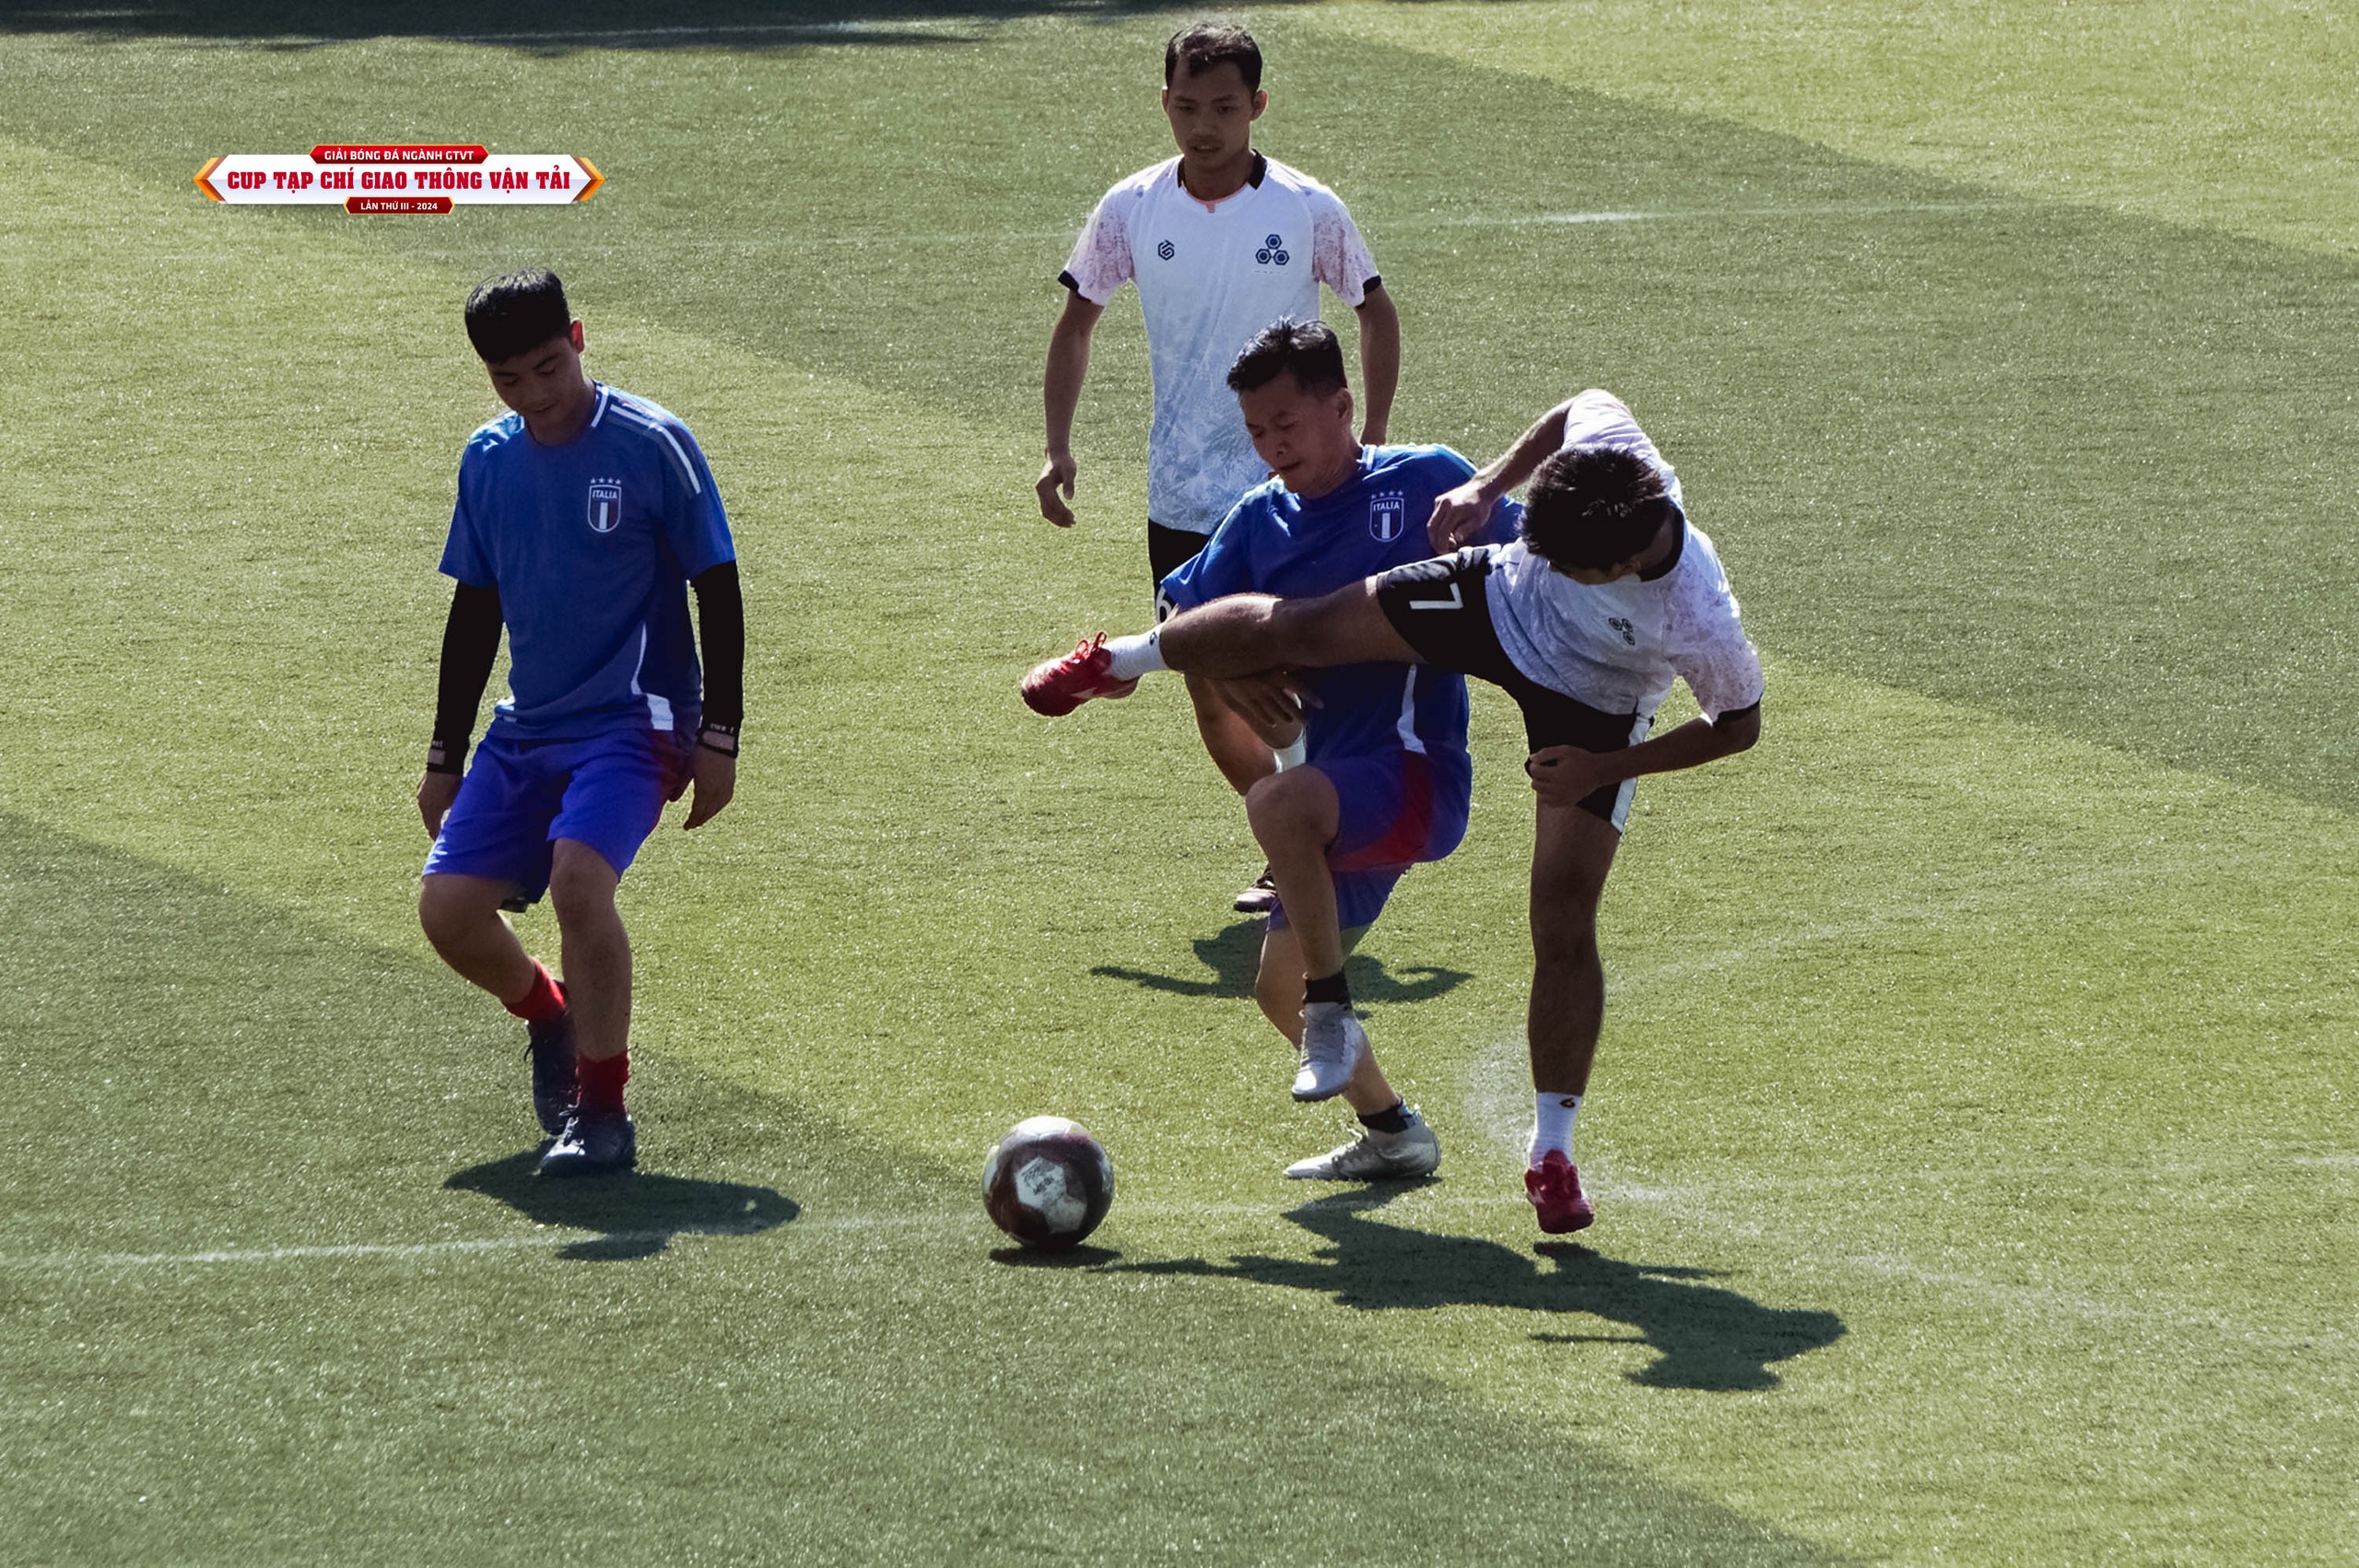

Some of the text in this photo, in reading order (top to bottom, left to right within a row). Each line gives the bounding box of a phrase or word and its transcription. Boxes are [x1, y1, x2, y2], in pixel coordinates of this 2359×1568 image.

[593, 489, 617, 498] ITALIA
[1373, 501, 1400, 511] ITALIA
[1409, 581, 1464, 610] 7
